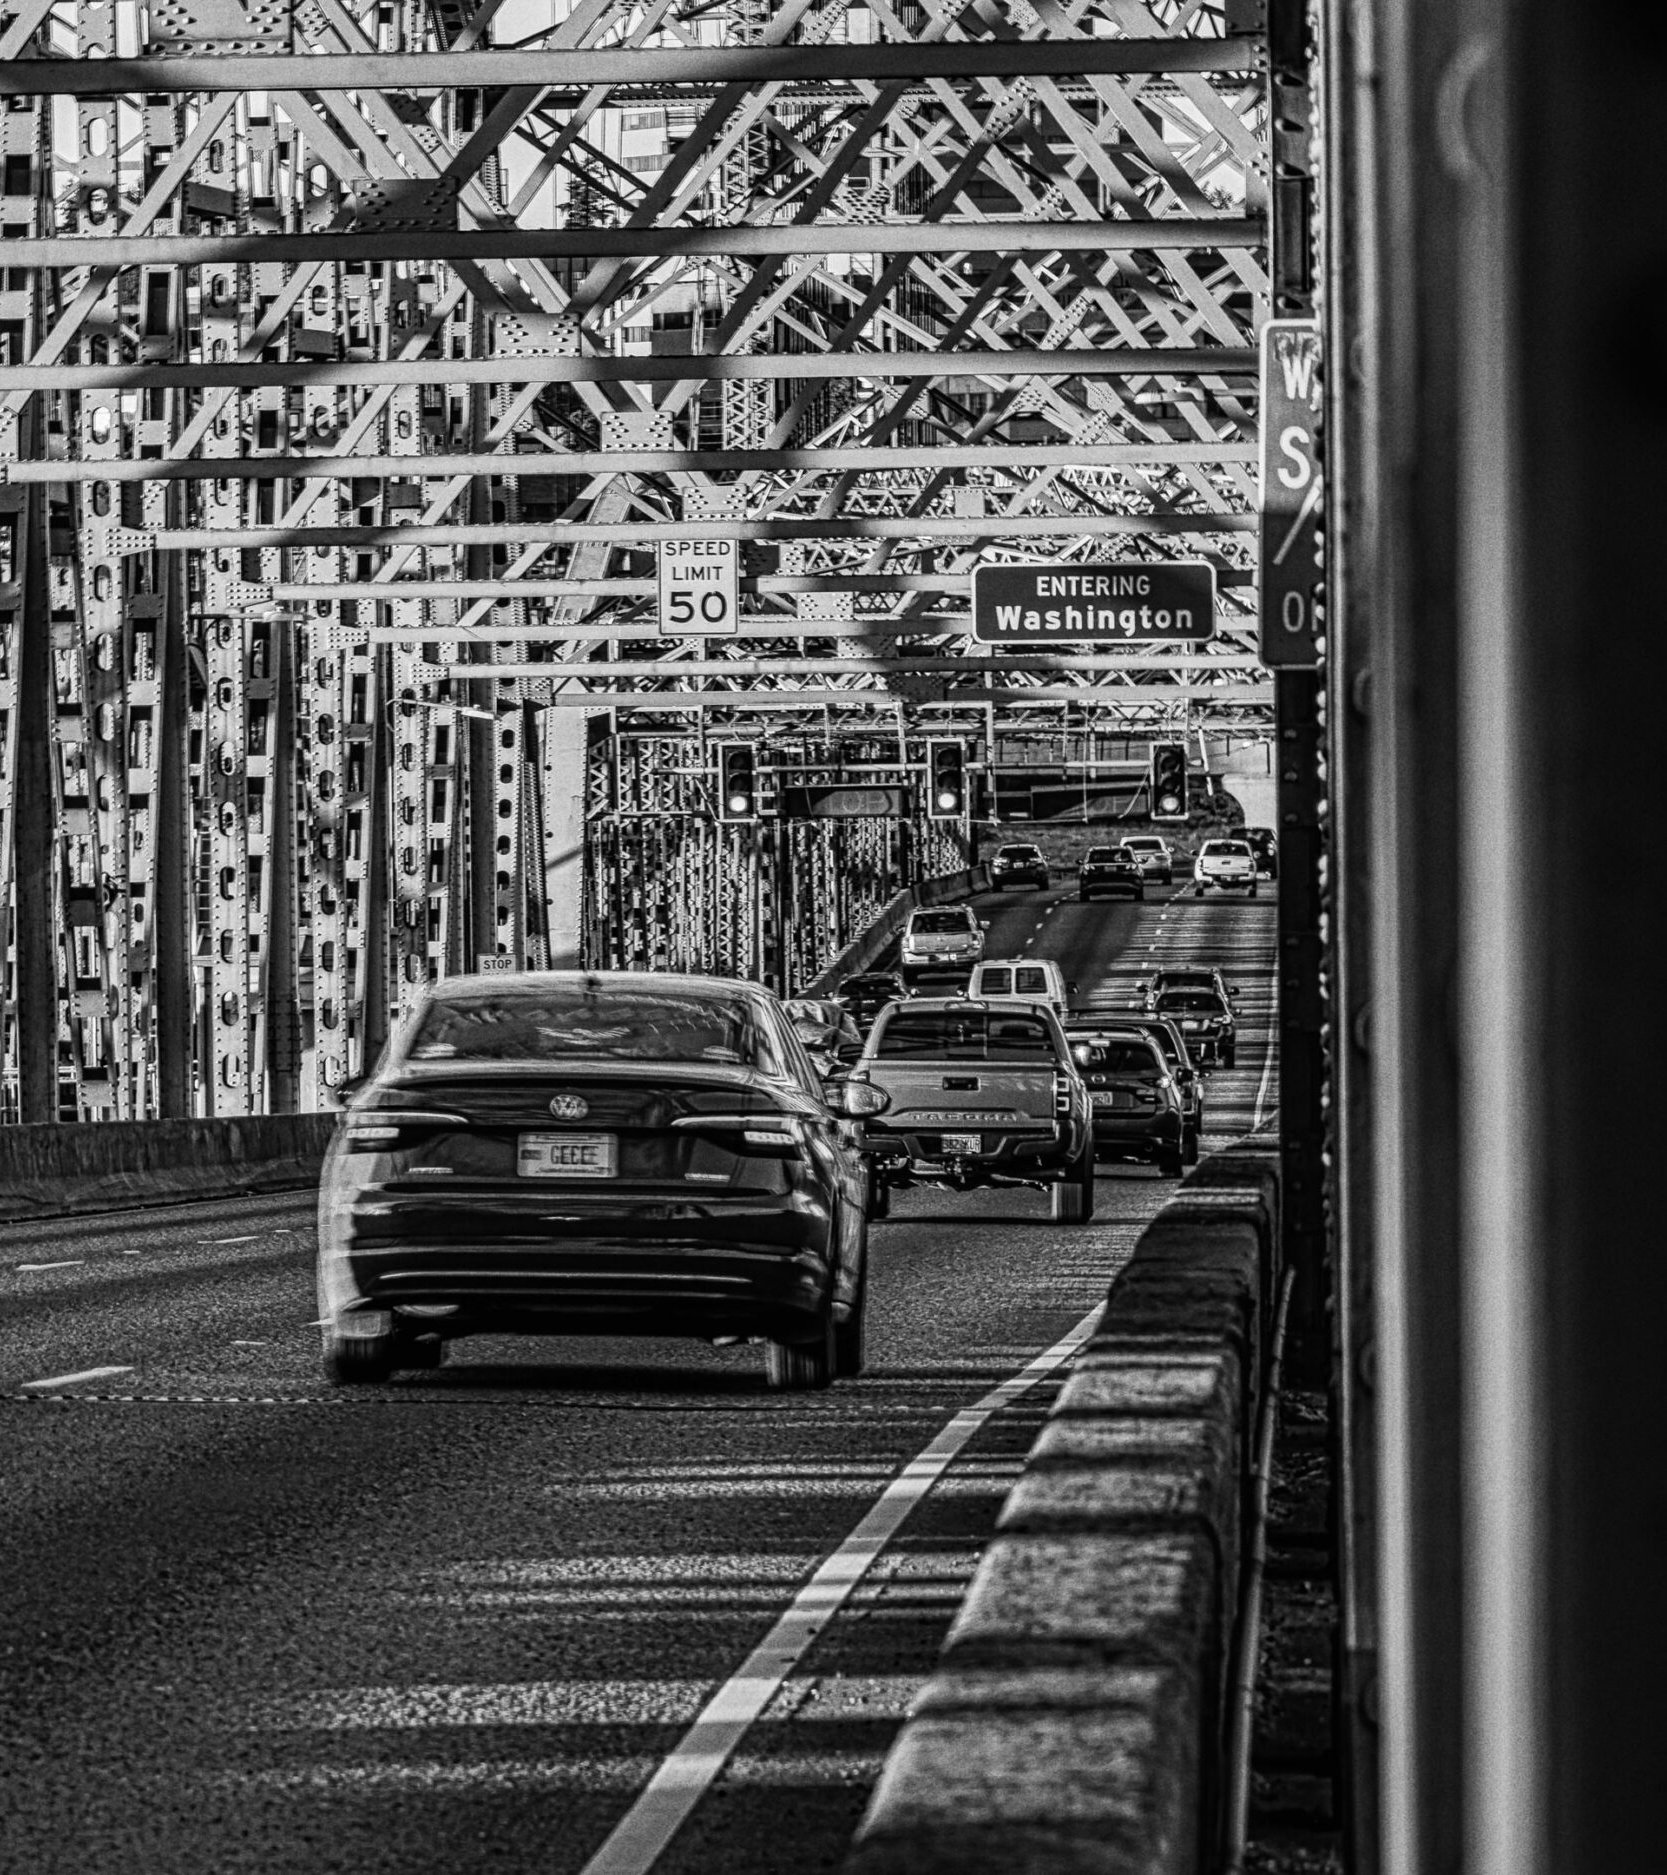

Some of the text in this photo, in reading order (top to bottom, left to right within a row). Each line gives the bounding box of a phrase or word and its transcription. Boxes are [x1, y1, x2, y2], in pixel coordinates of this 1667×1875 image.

[665, 541, 730, 556] SPEED
[672, 566, 724, 581] LIMIT
[1036, 575, 1151, 597] ENTERING
[669, 591, 728, 624] 50
[995, 605, 1193, 637] Washington
[483, 959, 512, 970] STOP
[909, 1111, 1017, 1121] TACOMA
